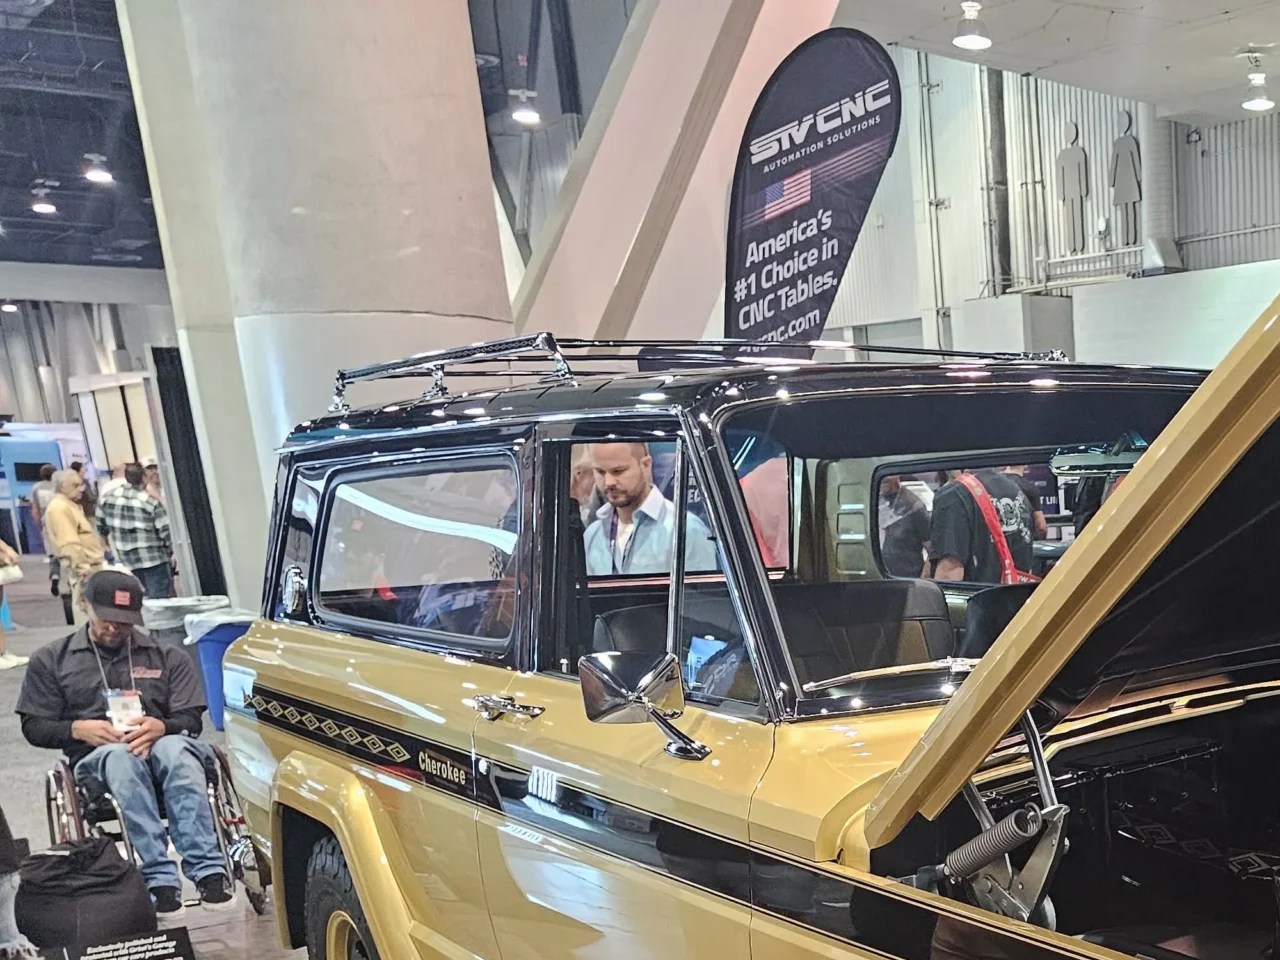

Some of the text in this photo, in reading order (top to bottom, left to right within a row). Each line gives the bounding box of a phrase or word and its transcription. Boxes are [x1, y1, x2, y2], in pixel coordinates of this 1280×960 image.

[763, 115, 881, 173] AUTOMATION SOLUTIONS
[745, 209, 832, 267] America's
[734, 237, 839, 302] #1 Choice in
[738, 270, 837, 330] CNC Tables.
[418, 750, 466, 785] Cherokee
